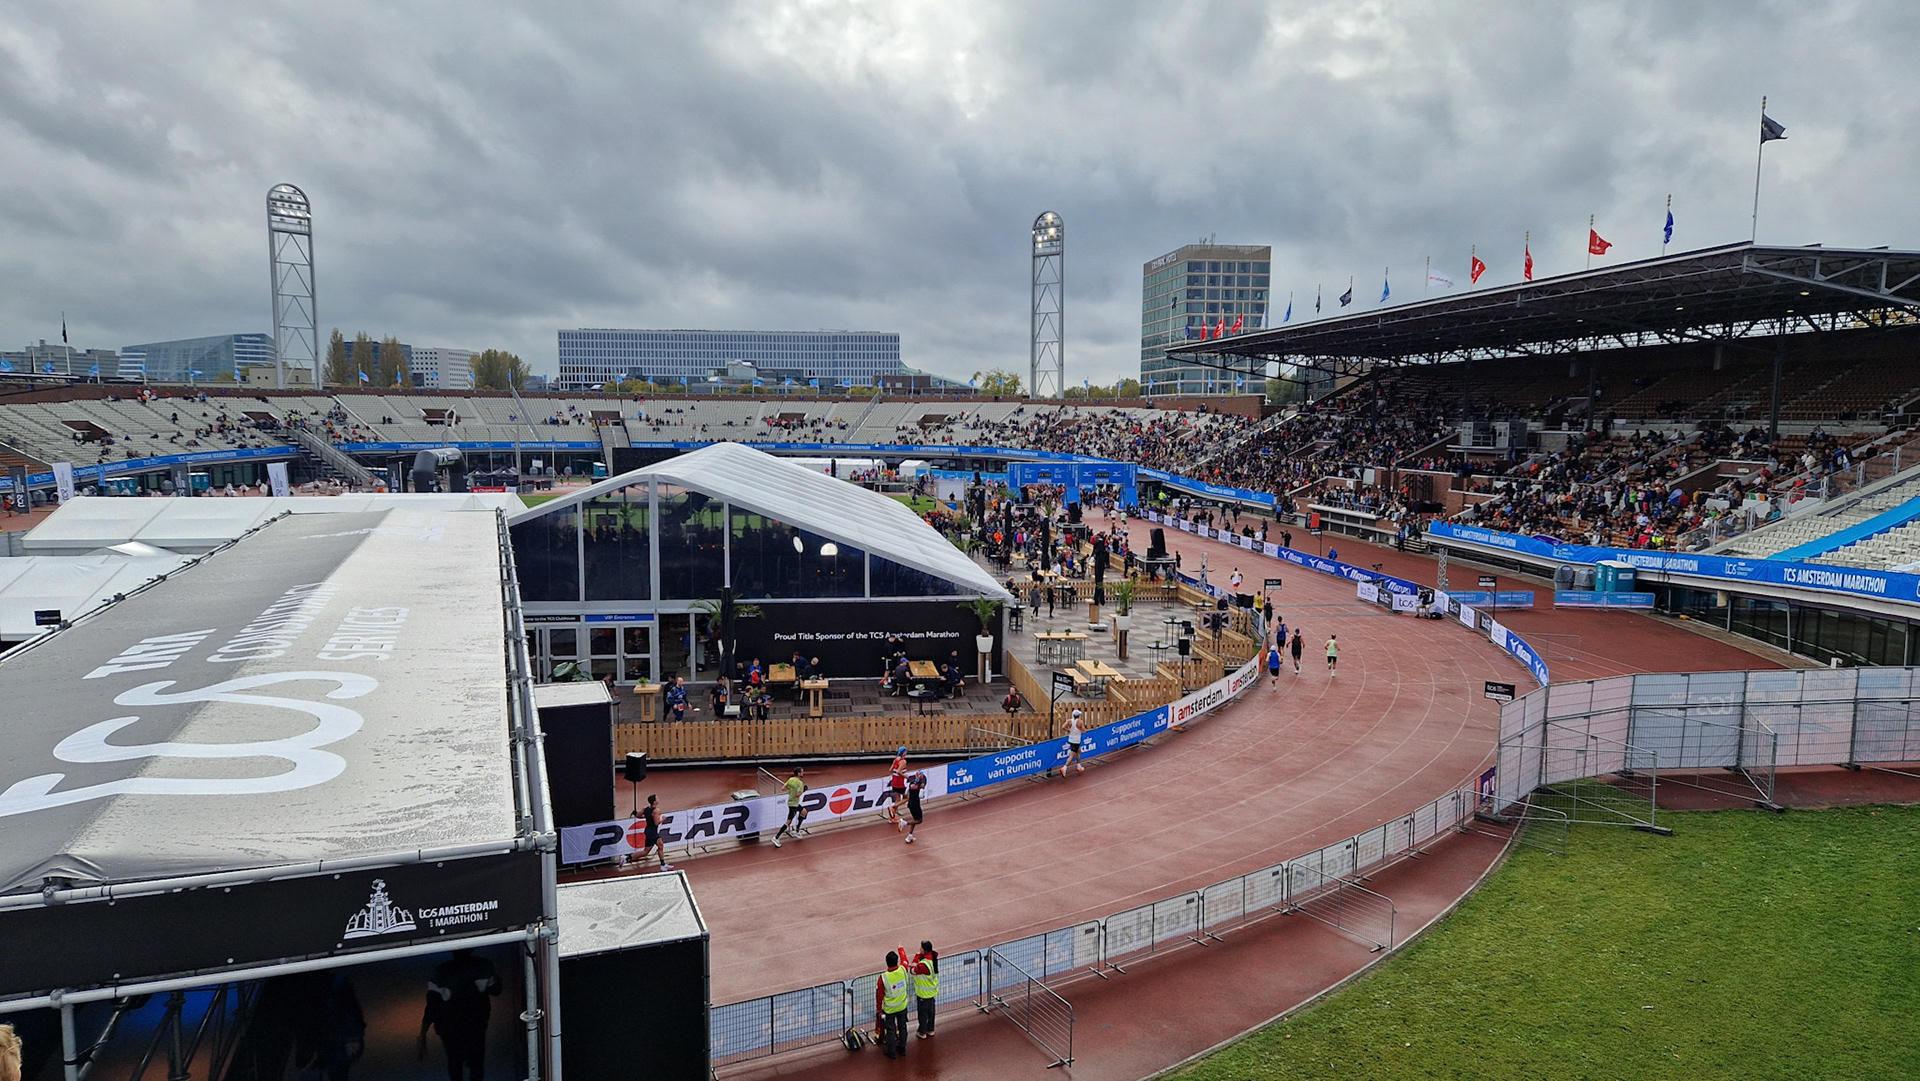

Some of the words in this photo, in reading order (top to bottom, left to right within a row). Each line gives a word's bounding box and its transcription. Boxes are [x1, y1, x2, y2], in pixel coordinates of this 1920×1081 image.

[1461, 530, 1490, 543] AMSTERDAM
[1316, 560, 1335, 573] Mizuno
[1616, 553, 1627, 563] TCS
[1627, 554, 1663, 568] AMSTERDAM
[1663, 557, 1699, 572] MARATHON
[1725, 560, 1737, 575] tcs
[1783, 567, 1797, 583] TCS
[1796, 568, 1843, 588] AMSTERDAM
[1843, 574, 1887, 593] MARATHON
[1398, 598, 1414, 608] tcs
[815, 633, 845, 641] Sponsor
[846, 632, 855, 640] of
[1170, 706, 1176, 724] I
[1111, 718, 1142, 735] Supporter
[1154, 718, 1168, 729] KLM
[1106, 736, 1119, 747] van
[1119, 727, 1146, 745] Running
[1080, 741, 1097, 753] KLM
[994, 748, 1037, 767] Supporter
[988, 768, 1005, 780] van
[1006, 759, 1042, 776] Running
[949, 773, 973, 786] KLM
[418, 907, 438, 920] tcs
[438, 899, 499, 918] AMSTERDAM
[434, 912, 483, 928] MARATHON
